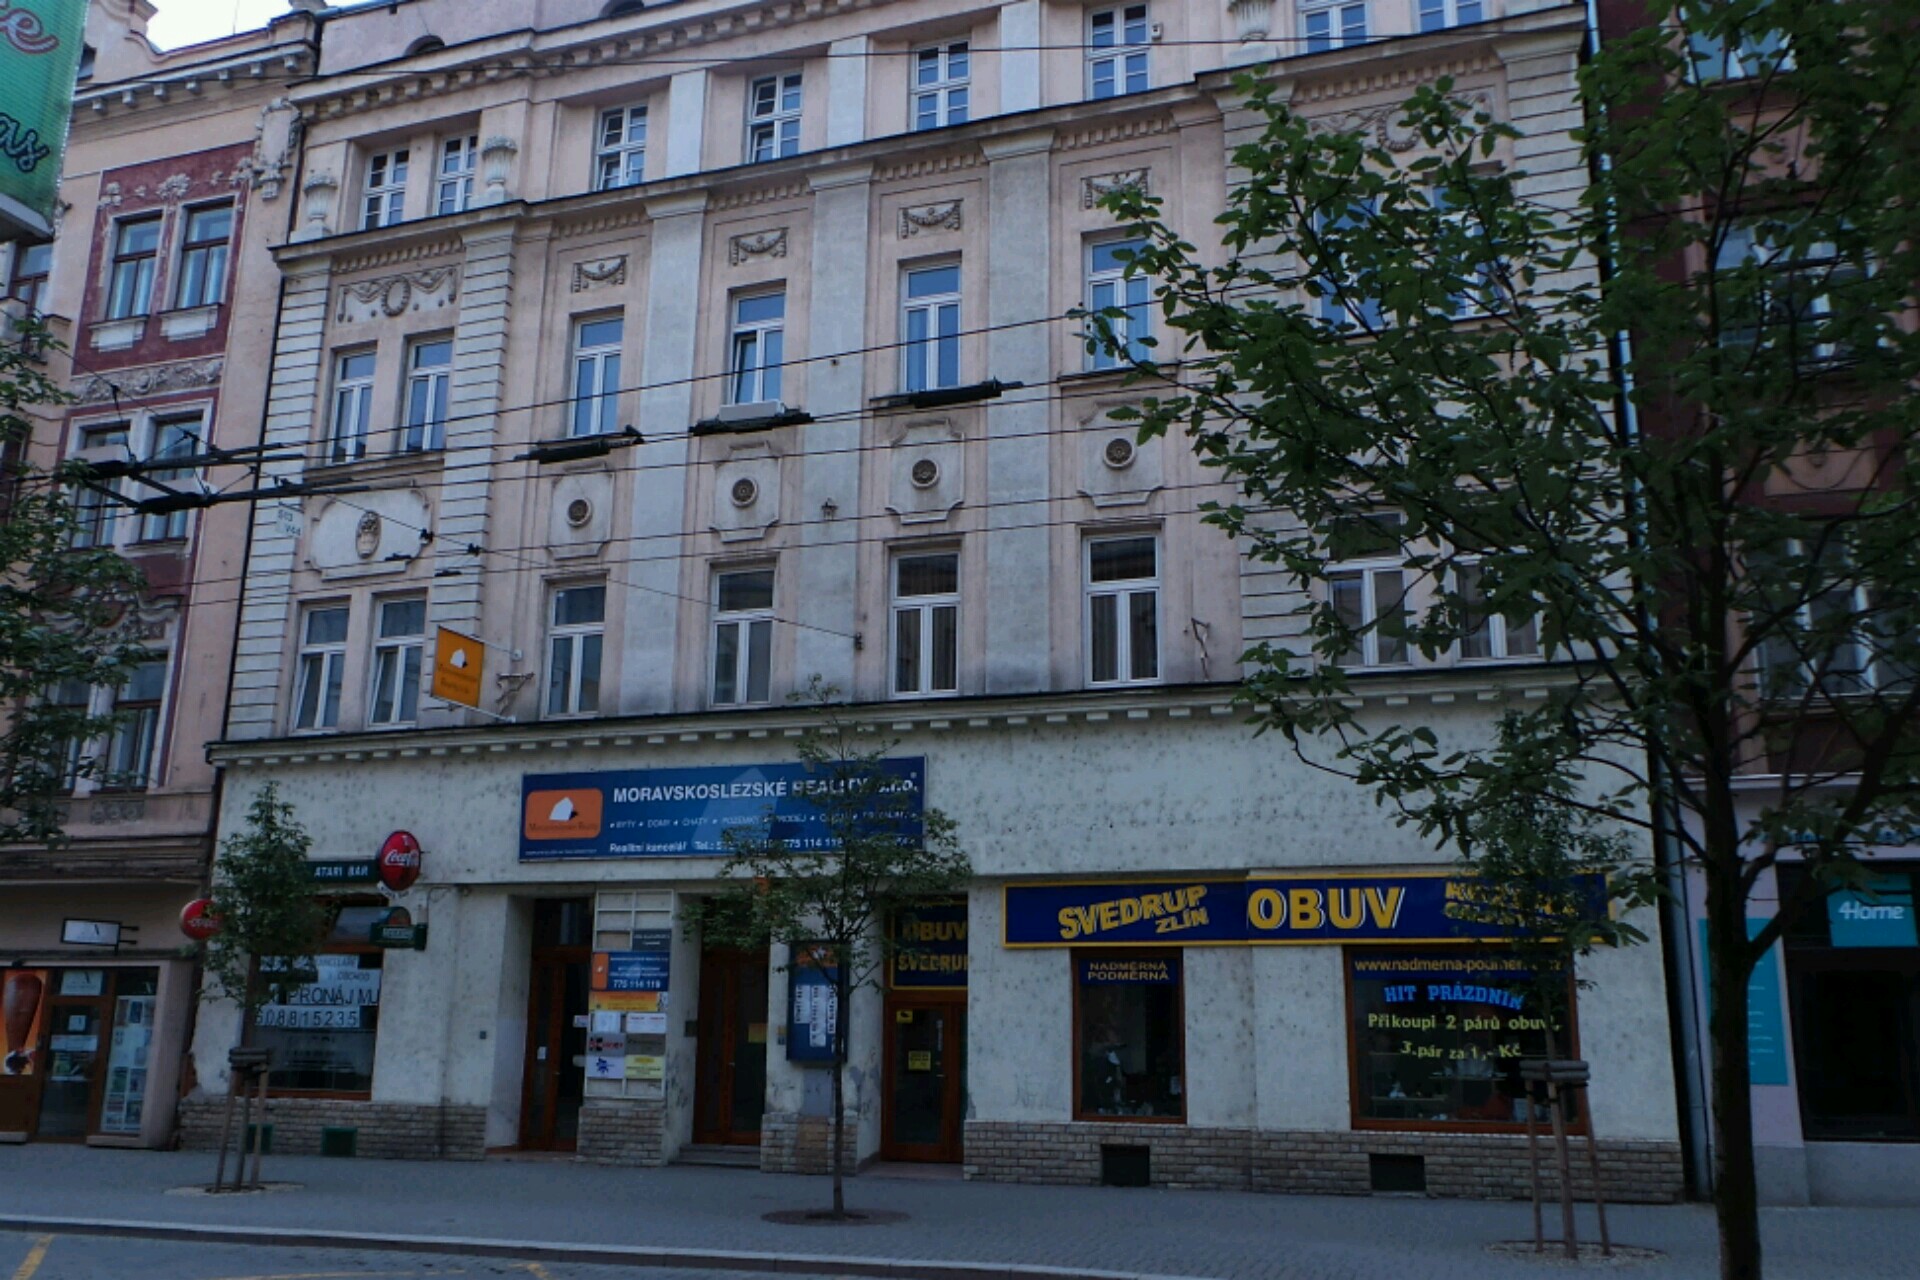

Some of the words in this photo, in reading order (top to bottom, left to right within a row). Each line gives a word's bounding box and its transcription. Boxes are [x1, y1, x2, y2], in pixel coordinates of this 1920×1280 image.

[613, 776, 787, 803] MORAVSKOSLEZSKÉ
[1058, 885, 1208, 939] SVEDRUP
[1155, 905, 1210, 934] ZLÍN
[1247, 886, 1406, 930] OBUV
[1838, 900, 1905, 920] 4Home
[1384, 984, 1417, 1003] HIT
[1445, 1014, 1457, 1029] 2
[1463, 1014, 1500, 1032] párů
[1448, 1048, 1465, 1060] za
[1498, 1042, 1522, 1058] Kč
